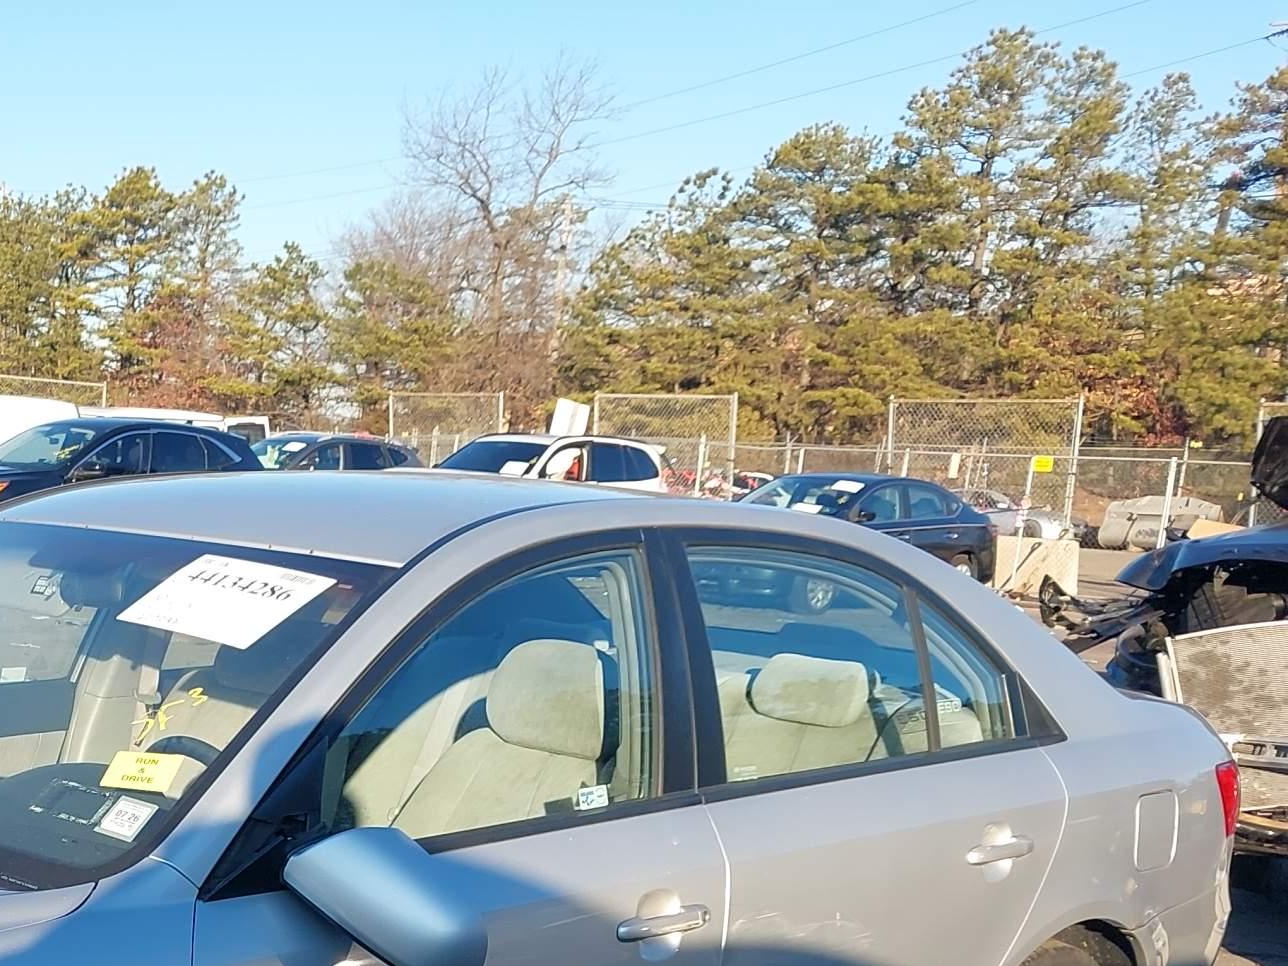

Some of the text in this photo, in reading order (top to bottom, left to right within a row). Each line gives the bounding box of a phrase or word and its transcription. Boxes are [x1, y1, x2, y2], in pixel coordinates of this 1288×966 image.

[187, 569, 294, 601] 44134286
[135, 757, 159, 765] RUN
[121, 774, 153, 784] DRIVE
